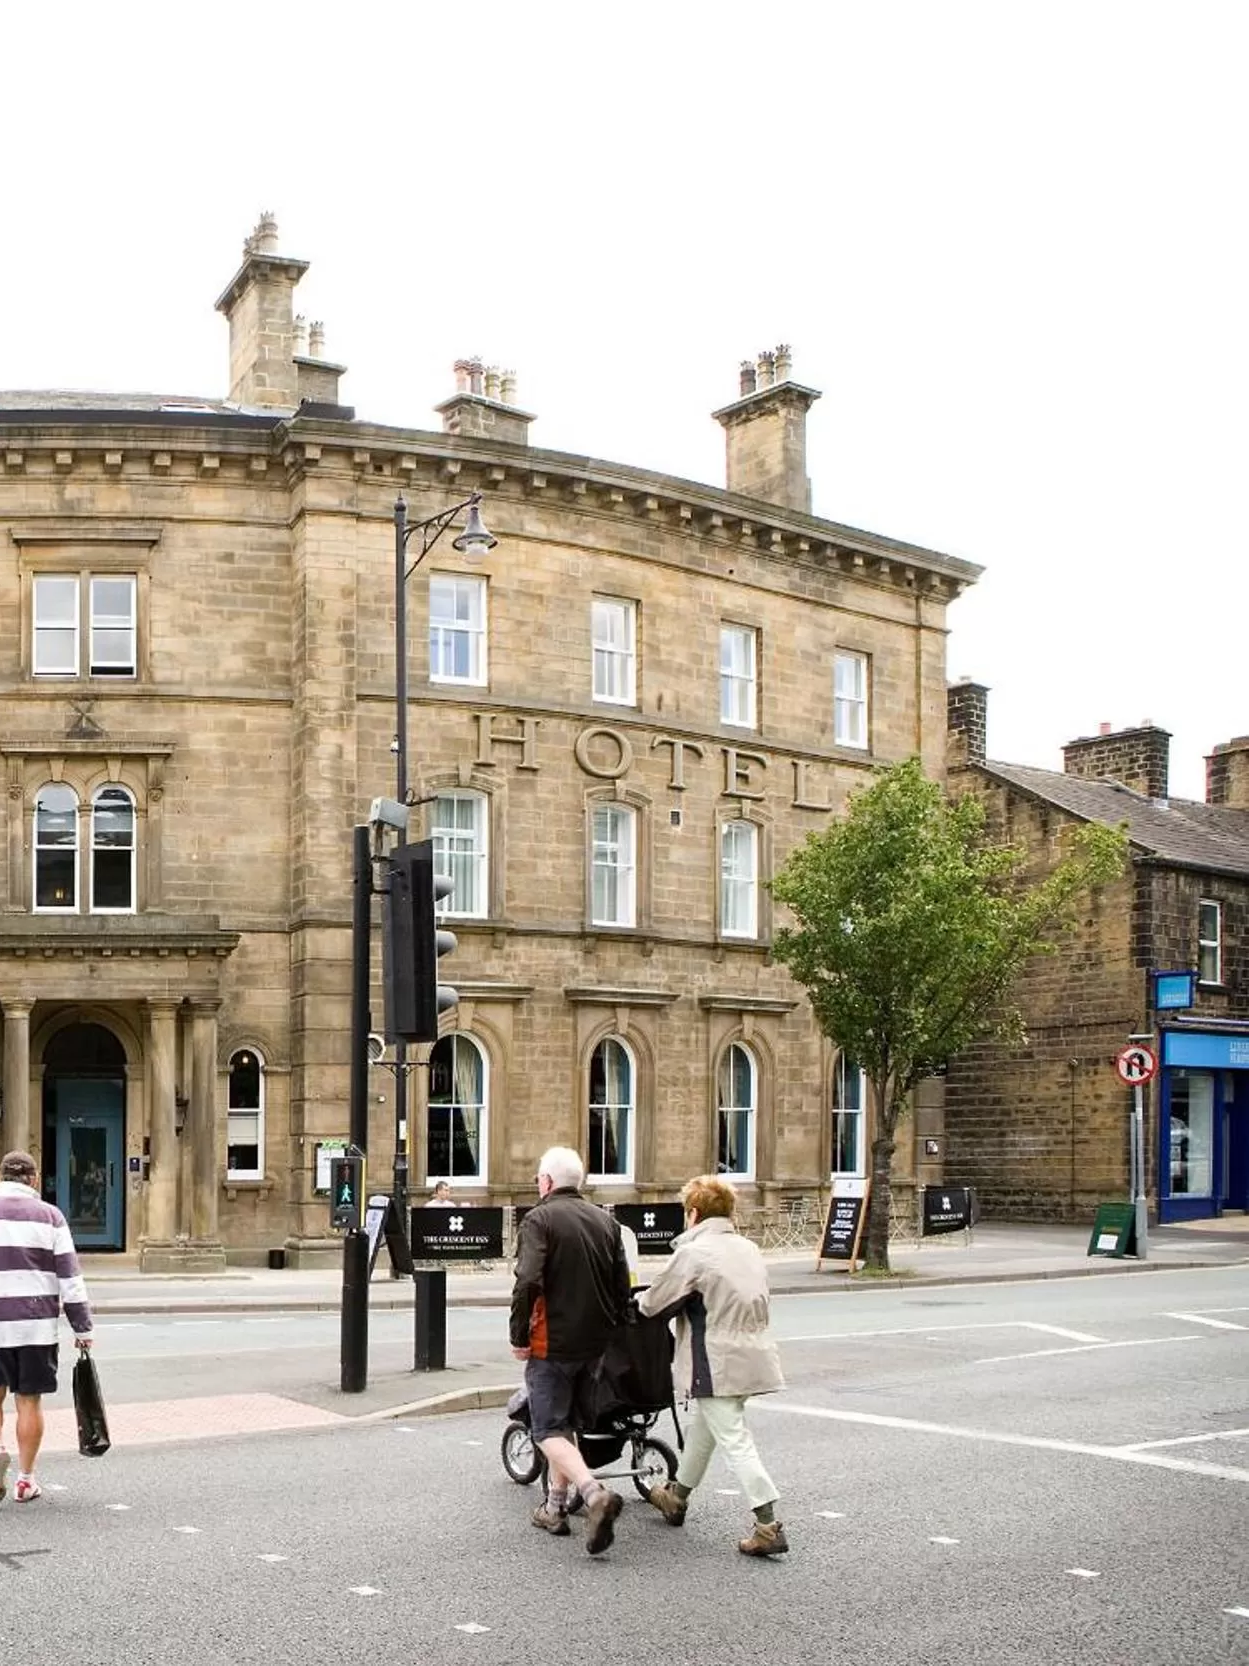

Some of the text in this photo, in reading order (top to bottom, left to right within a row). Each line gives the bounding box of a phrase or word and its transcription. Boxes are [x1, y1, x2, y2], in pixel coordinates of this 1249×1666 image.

[472, 712, 832, 812] HOTEL
[423, 1235, 439, 1244] THE
[438, 1235, 475, 1244] CRESCENT
